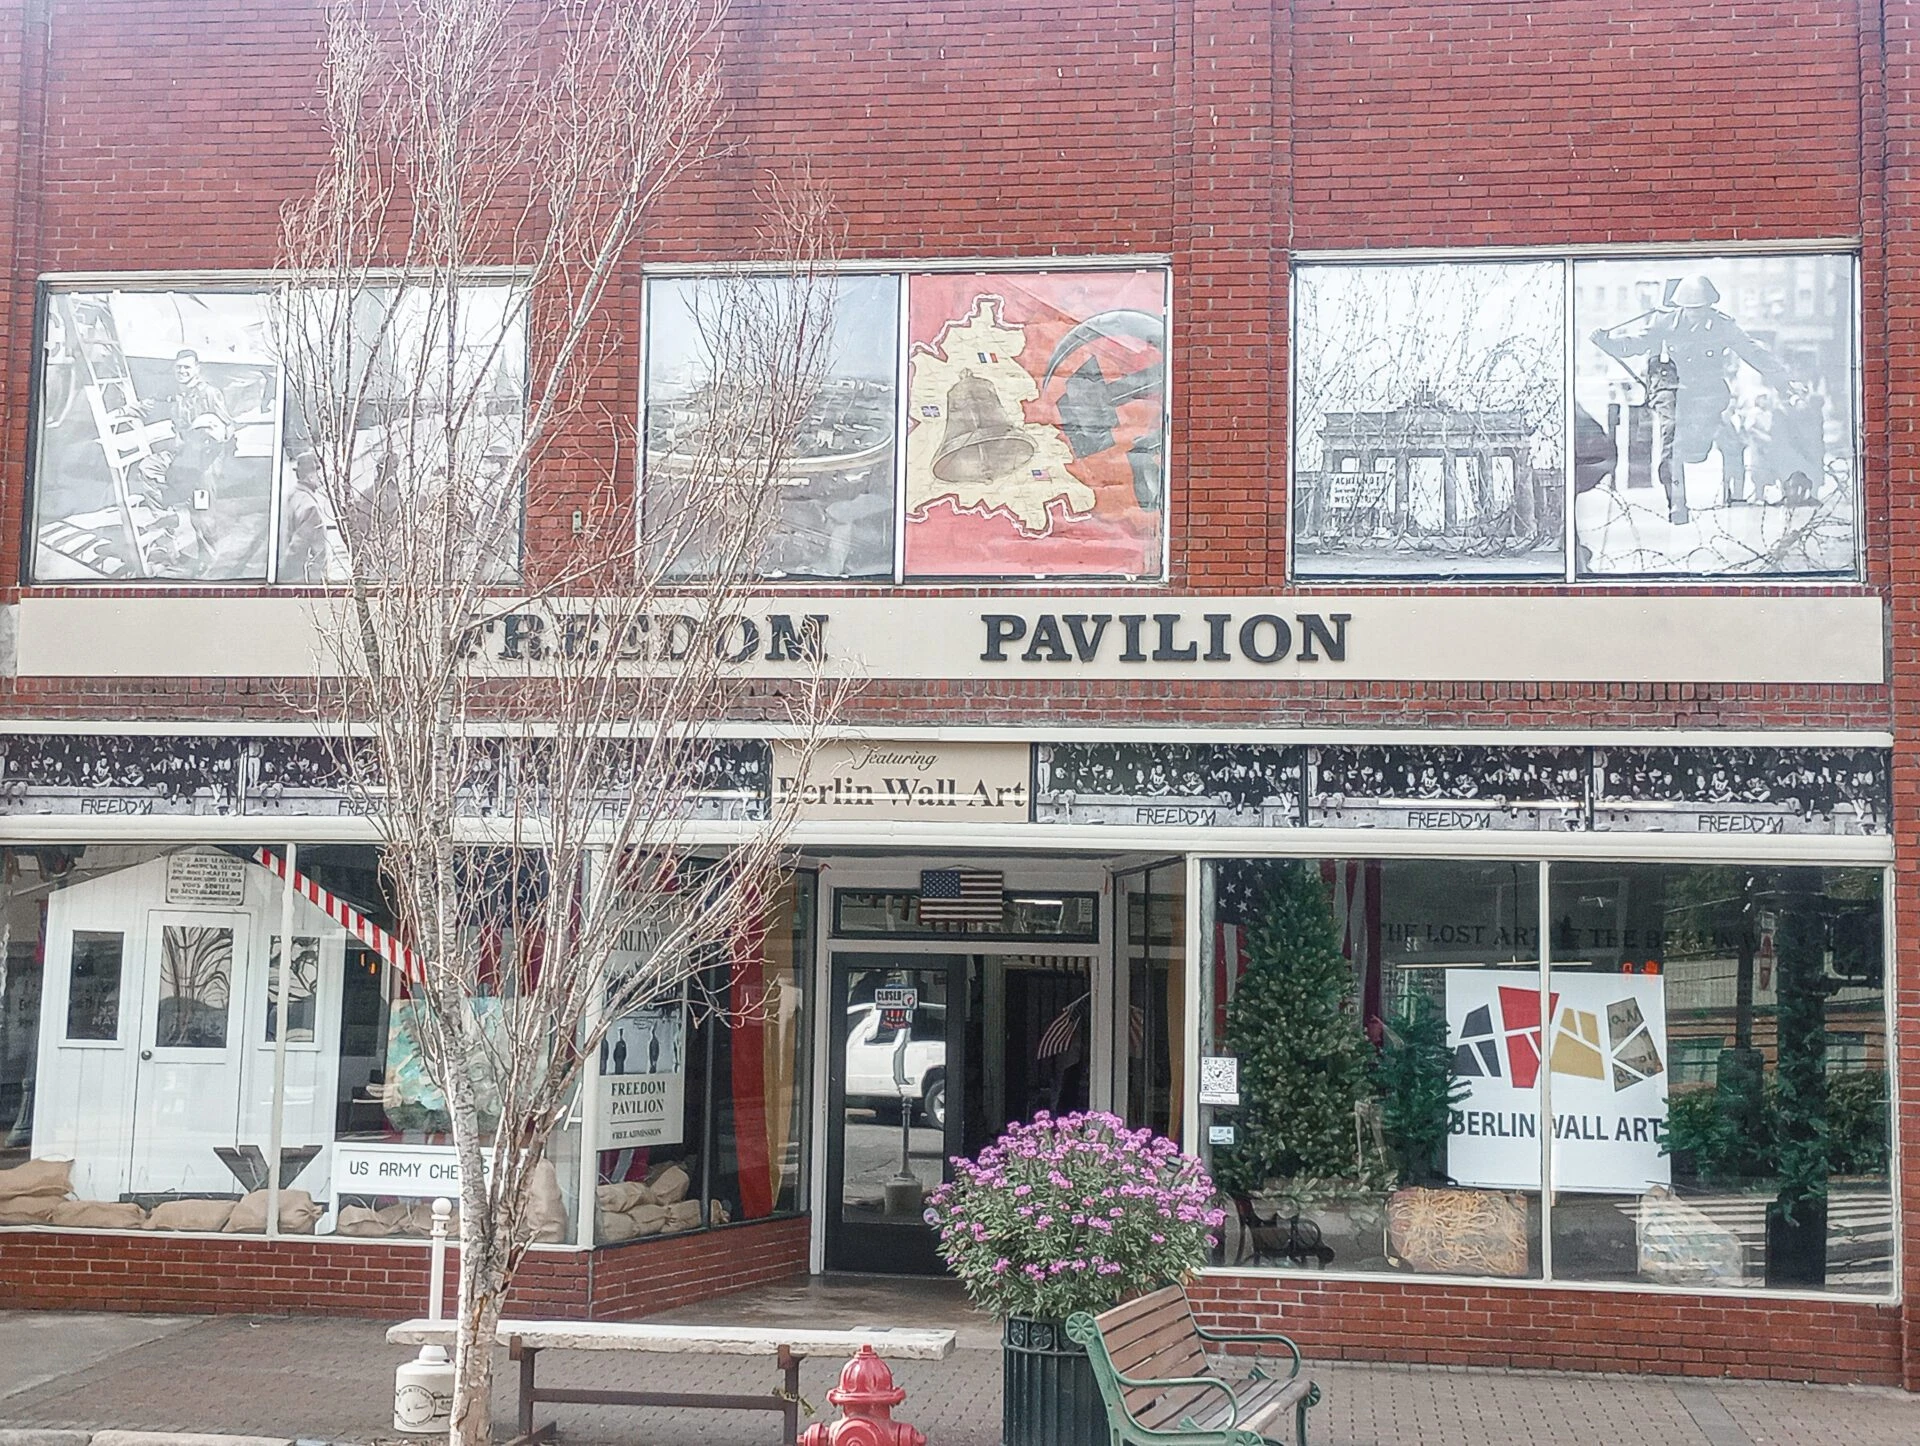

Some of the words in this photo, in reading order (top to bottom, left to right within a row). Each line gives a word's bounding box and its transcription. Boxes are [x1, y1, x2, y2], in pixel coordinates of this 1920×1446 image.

[980, 613, 1352, 663] PAVILION
[852, 749, 939, 771] featuring
[777, 777, 875, 805] Berlin
[882, 778, 957, 807] Wall
[967, 778, 1026, 808] Art
[81, 799, 153, 815] FREEDOM
[1136, 807, 1217, 826] FREEDOM
[1408, 811, 1491, 829] FREEDOM
[1698, 814, 1784, 834] FREEDOM
[1426, 924, 1486, 945] LOST
[611, 1081, 666, 1097] FREEDOM
[612, 1099, 664, 1116] PAVILION
[1451, 1110, 1536, 1138] BERLIN
[1615, 1117, 1663, 1143] ART
[350, 1161, 369, 1175] US
[379, 1162, 422, 1178] ARMY
